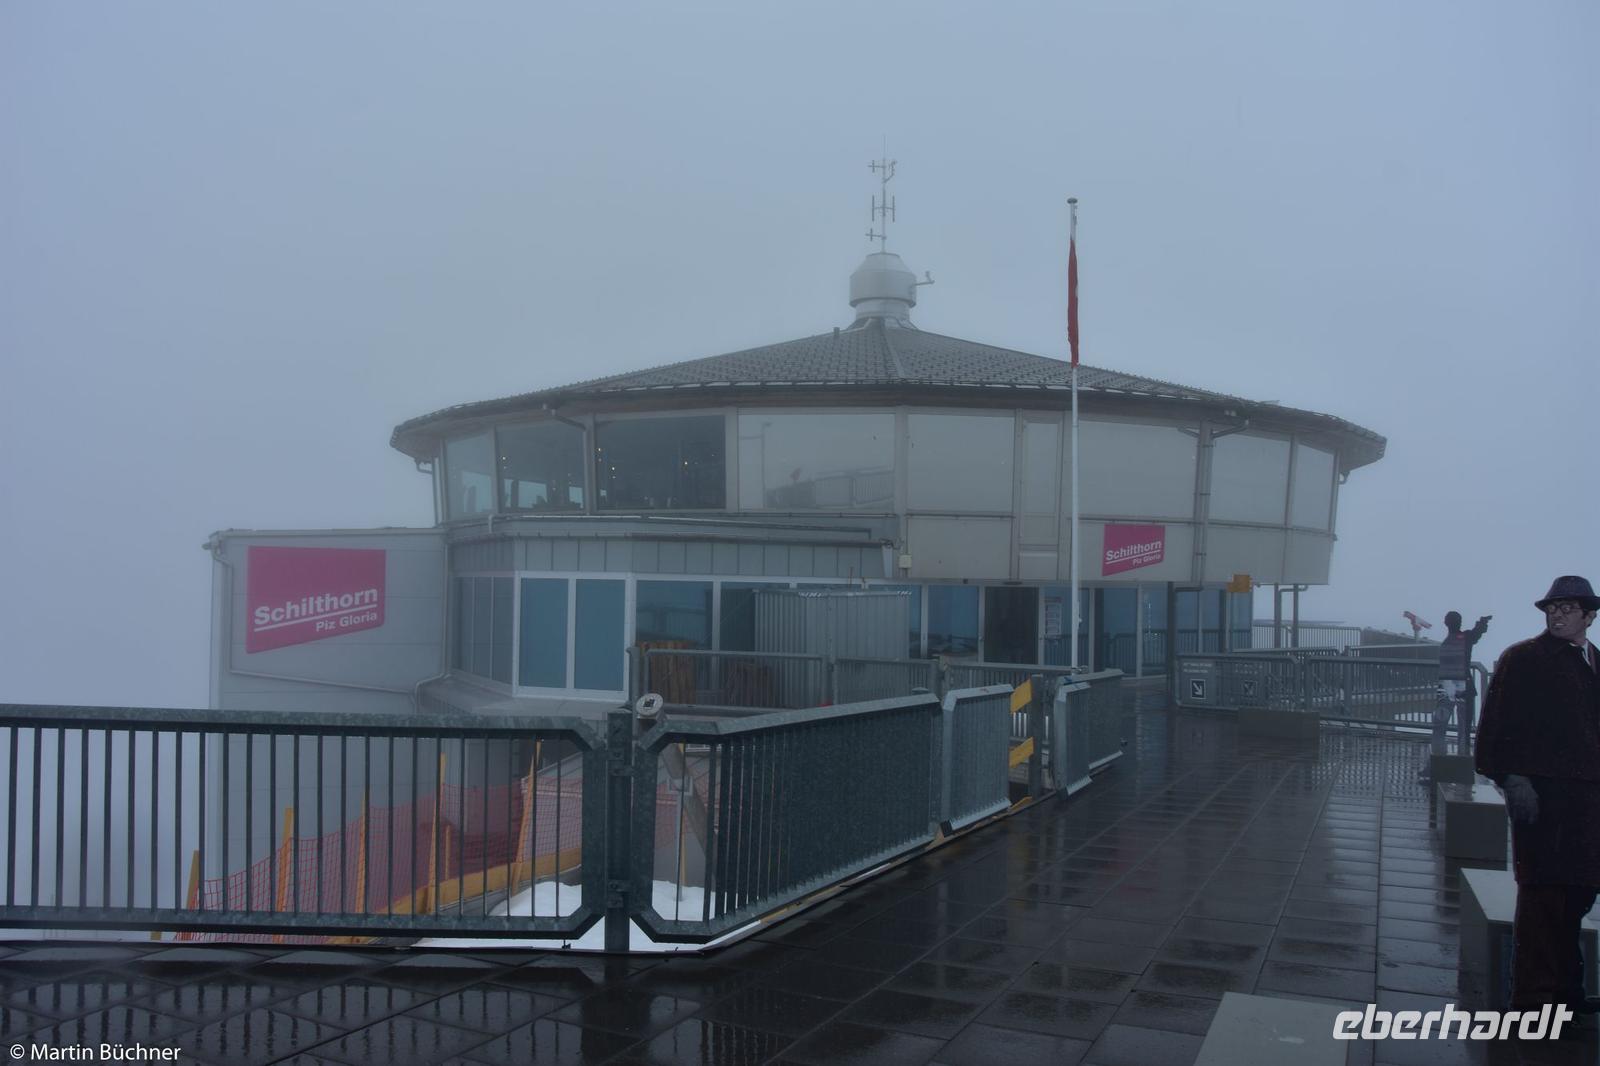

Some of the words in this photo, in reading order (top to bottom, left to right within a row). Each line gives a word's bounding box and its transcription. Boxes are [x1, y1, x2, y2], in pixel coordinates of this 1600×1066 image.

[1106, 541, 1161, 561] Schilthorn
[1132, 558, 1142, 566] Piz
[254, 588, 378, 625] Schilthorn
[315, 621, 336, 632] Piz
[339, 611, 377, 627] Gloria
